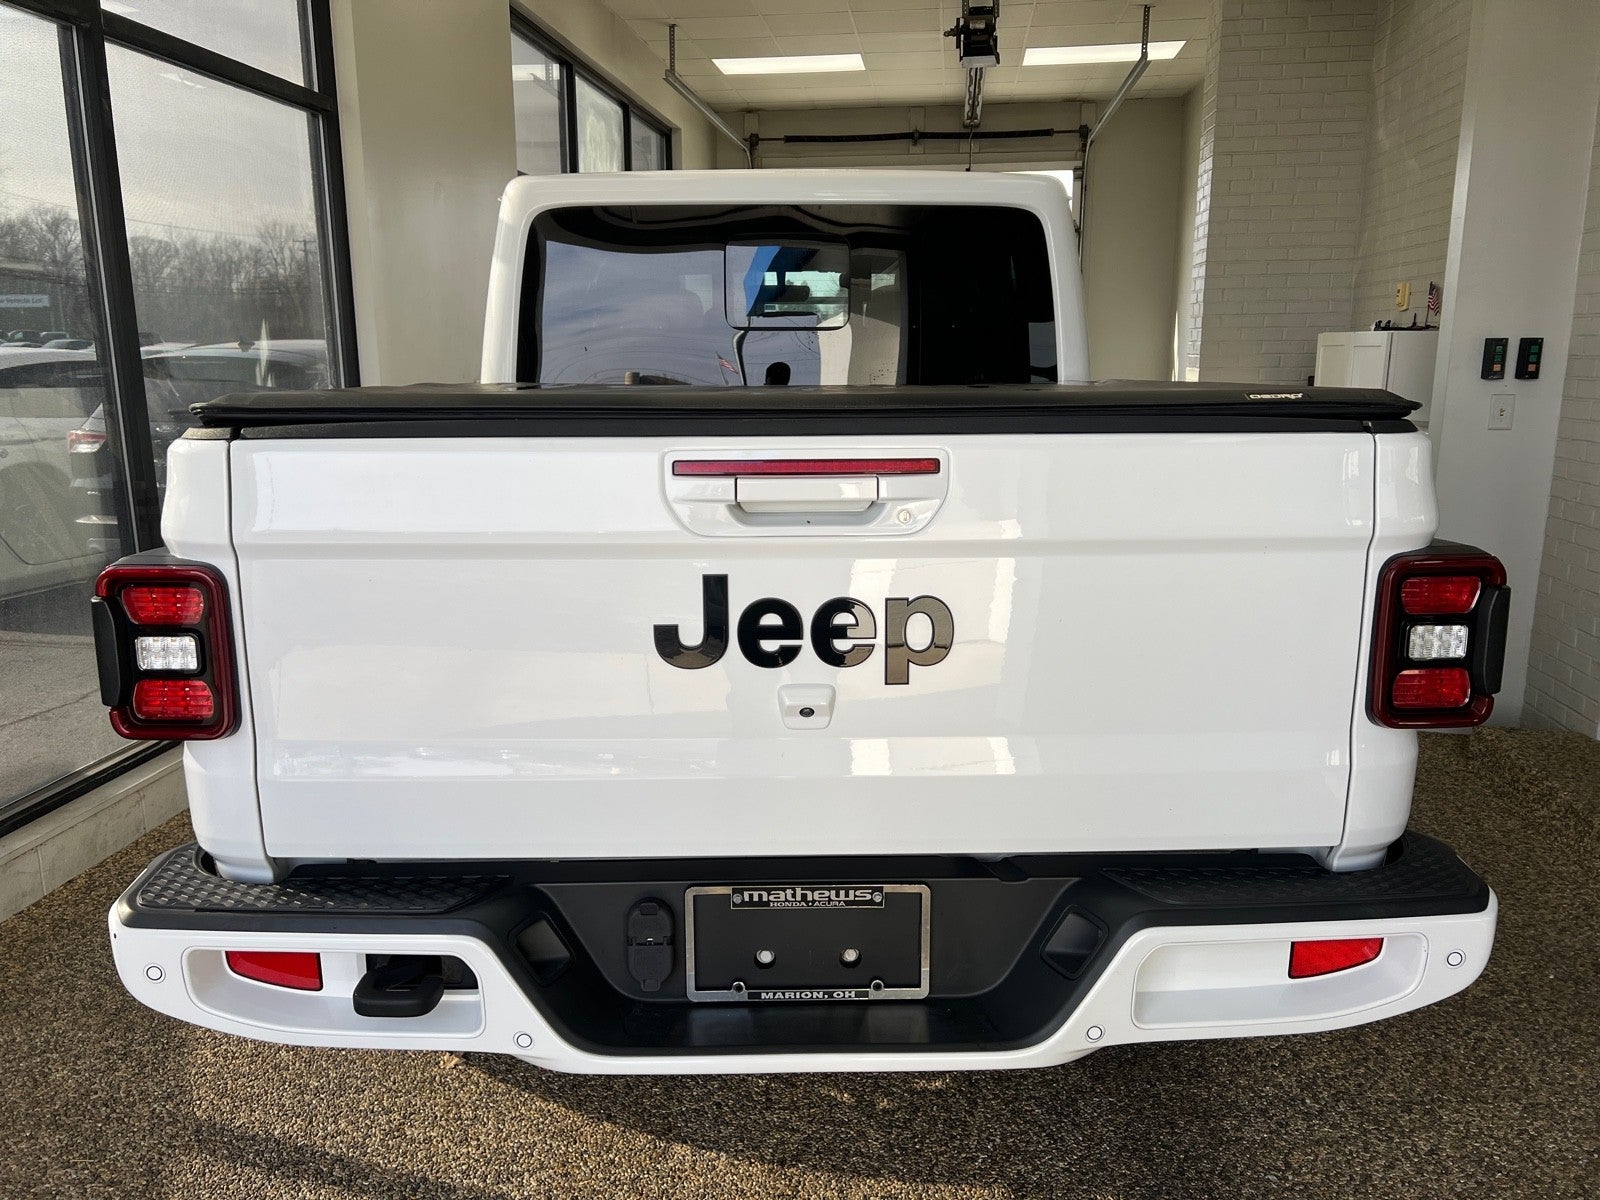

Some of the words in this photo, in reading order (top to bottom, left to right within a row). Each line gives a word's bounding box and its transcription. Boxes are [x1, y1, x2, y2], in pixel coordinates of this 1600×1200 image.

[653, 573, 955, 685] Jeep
[743, 887, 872, 902] mathews
[761, 991, 828, 999] MARION,
[833, 990, 856, 998] OH
